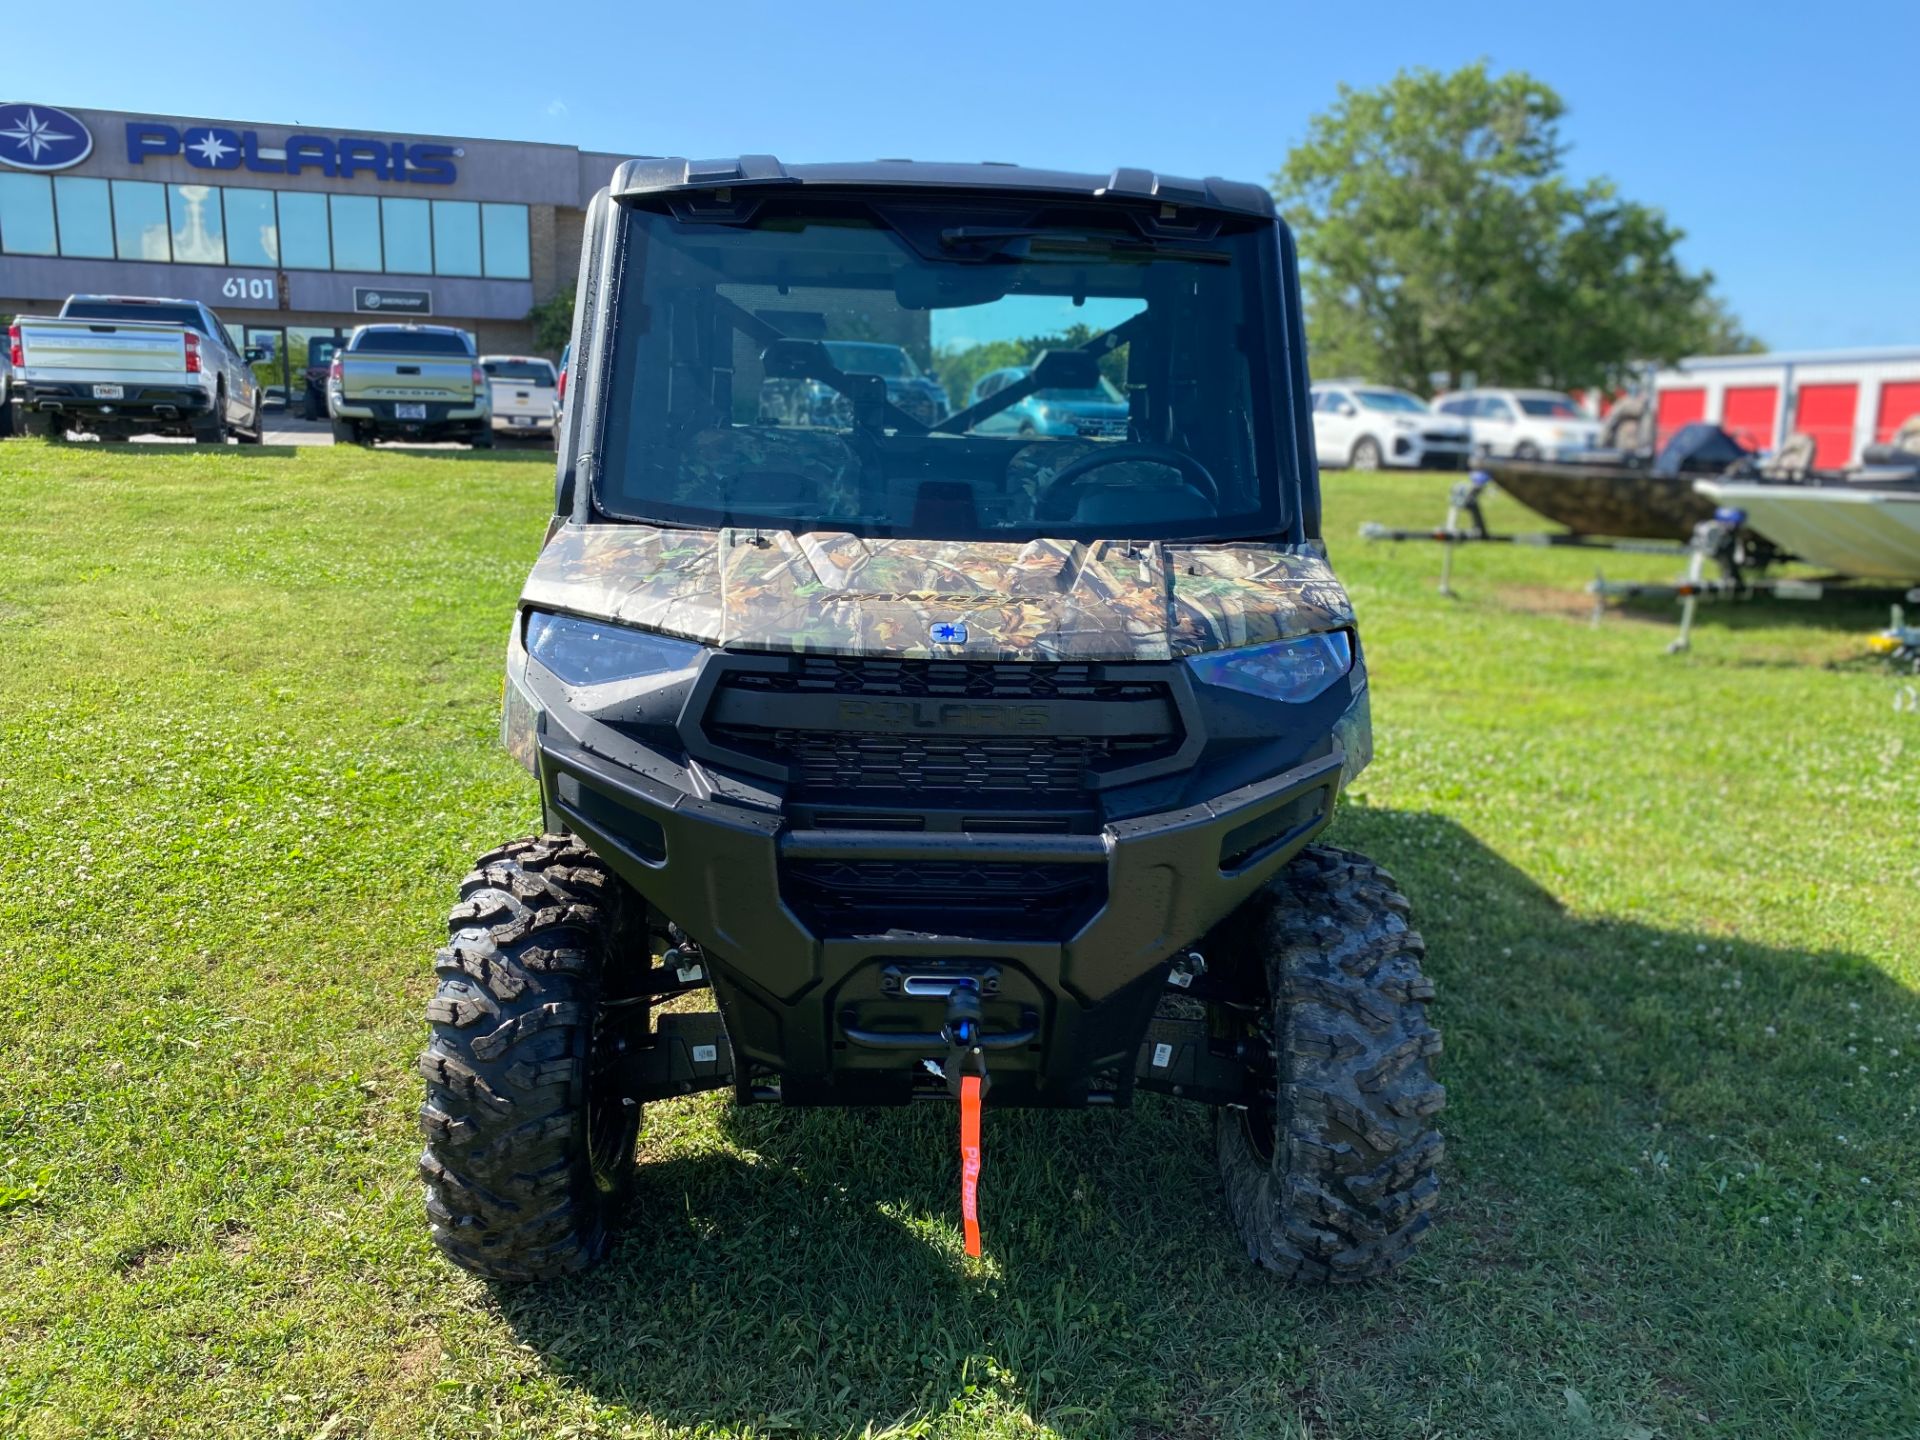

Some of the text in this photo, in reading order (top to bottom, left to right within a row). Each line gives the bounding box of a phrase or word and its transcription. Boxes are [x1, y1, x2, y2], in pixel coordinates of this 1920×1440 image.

[126, 122, 457, 185] POLARIS
[222, 277, 274, 300] 6101
[819, 593, 1045, 604] RANGER
[838, 699, 1050, 729] POLARIS
[965, 1147, 978, 1220] POLARIS
